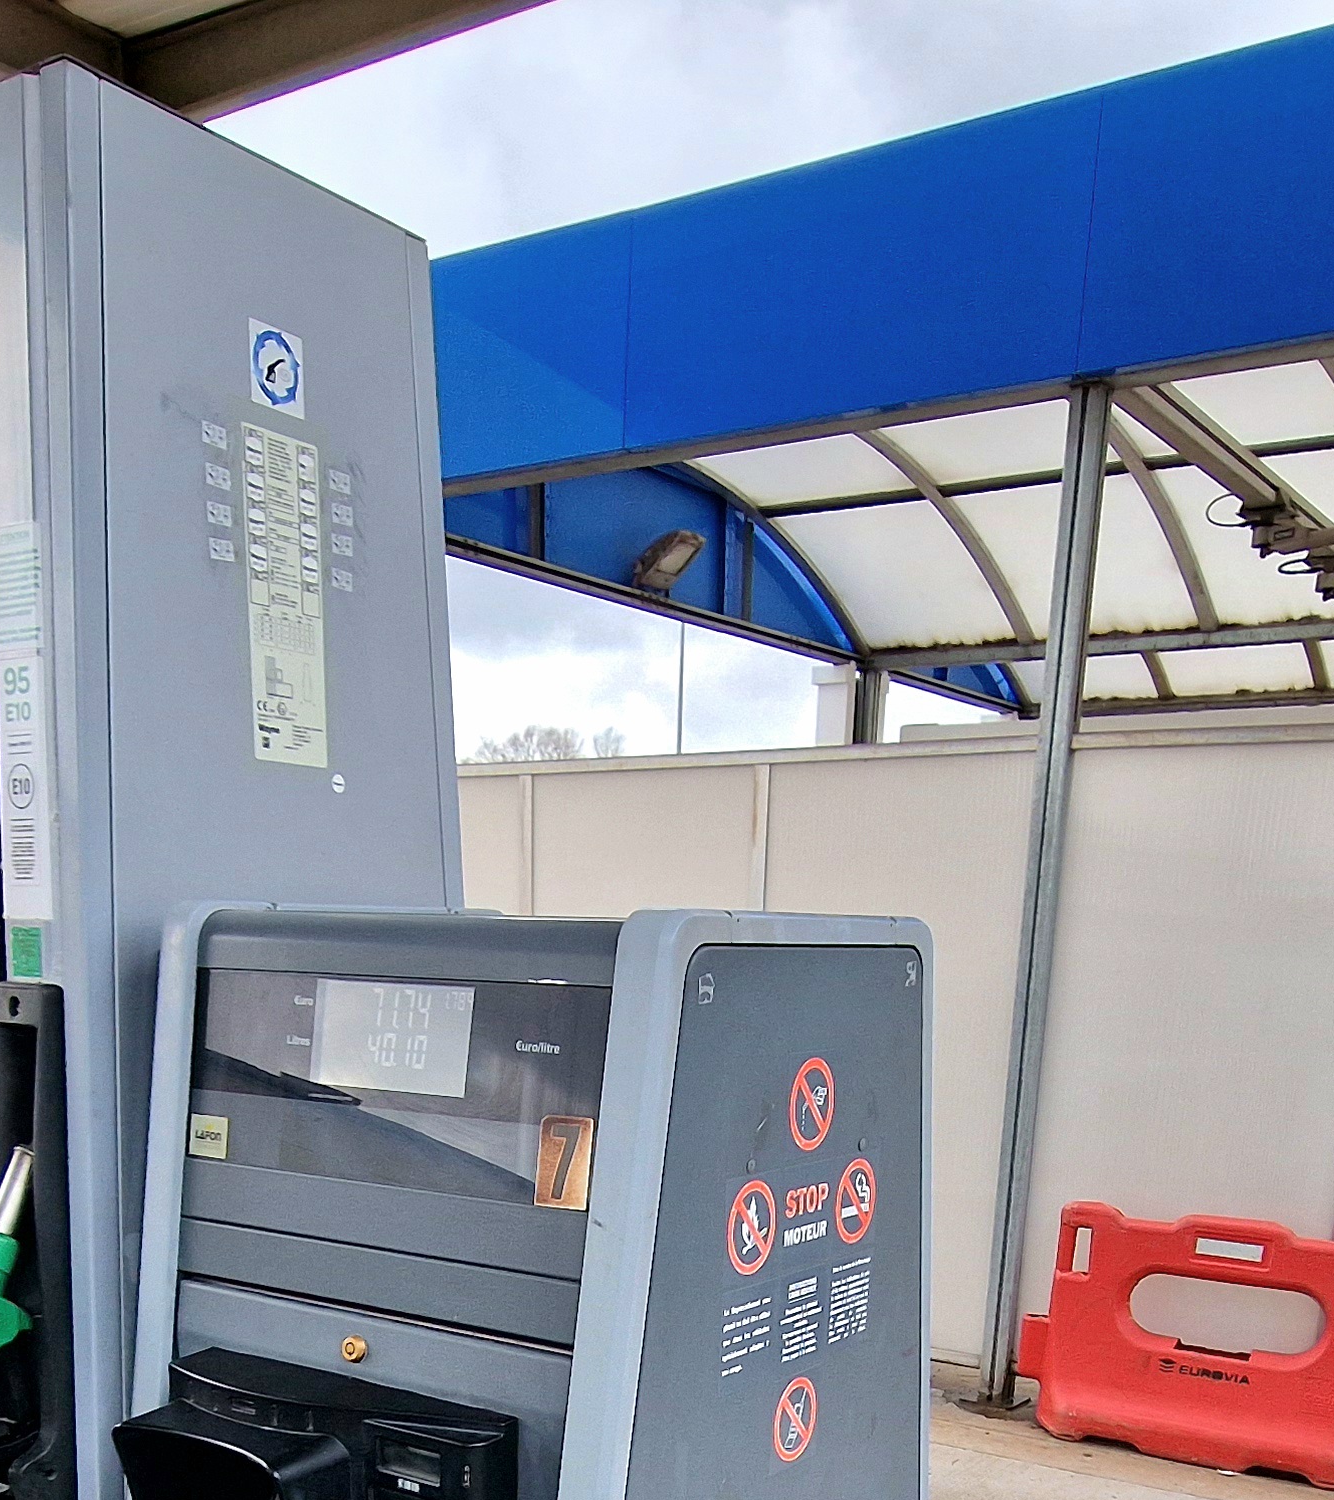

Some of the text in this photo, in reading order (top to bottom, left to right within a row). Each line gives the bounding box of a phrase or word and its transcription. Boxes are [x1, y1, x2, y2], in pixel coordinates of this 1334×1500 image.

[3, 666, 30, 696] 95
[5, 701, 31, 723] E10
[12, 778, 30, 796] E10
[549, 1123, 583, 1201] 7
[784, 1182, 830, 1220] STOP
[783, 1219, 828, 1248] MOTEUR
[1178, 1364, 1251, 1386] EUROVIA
